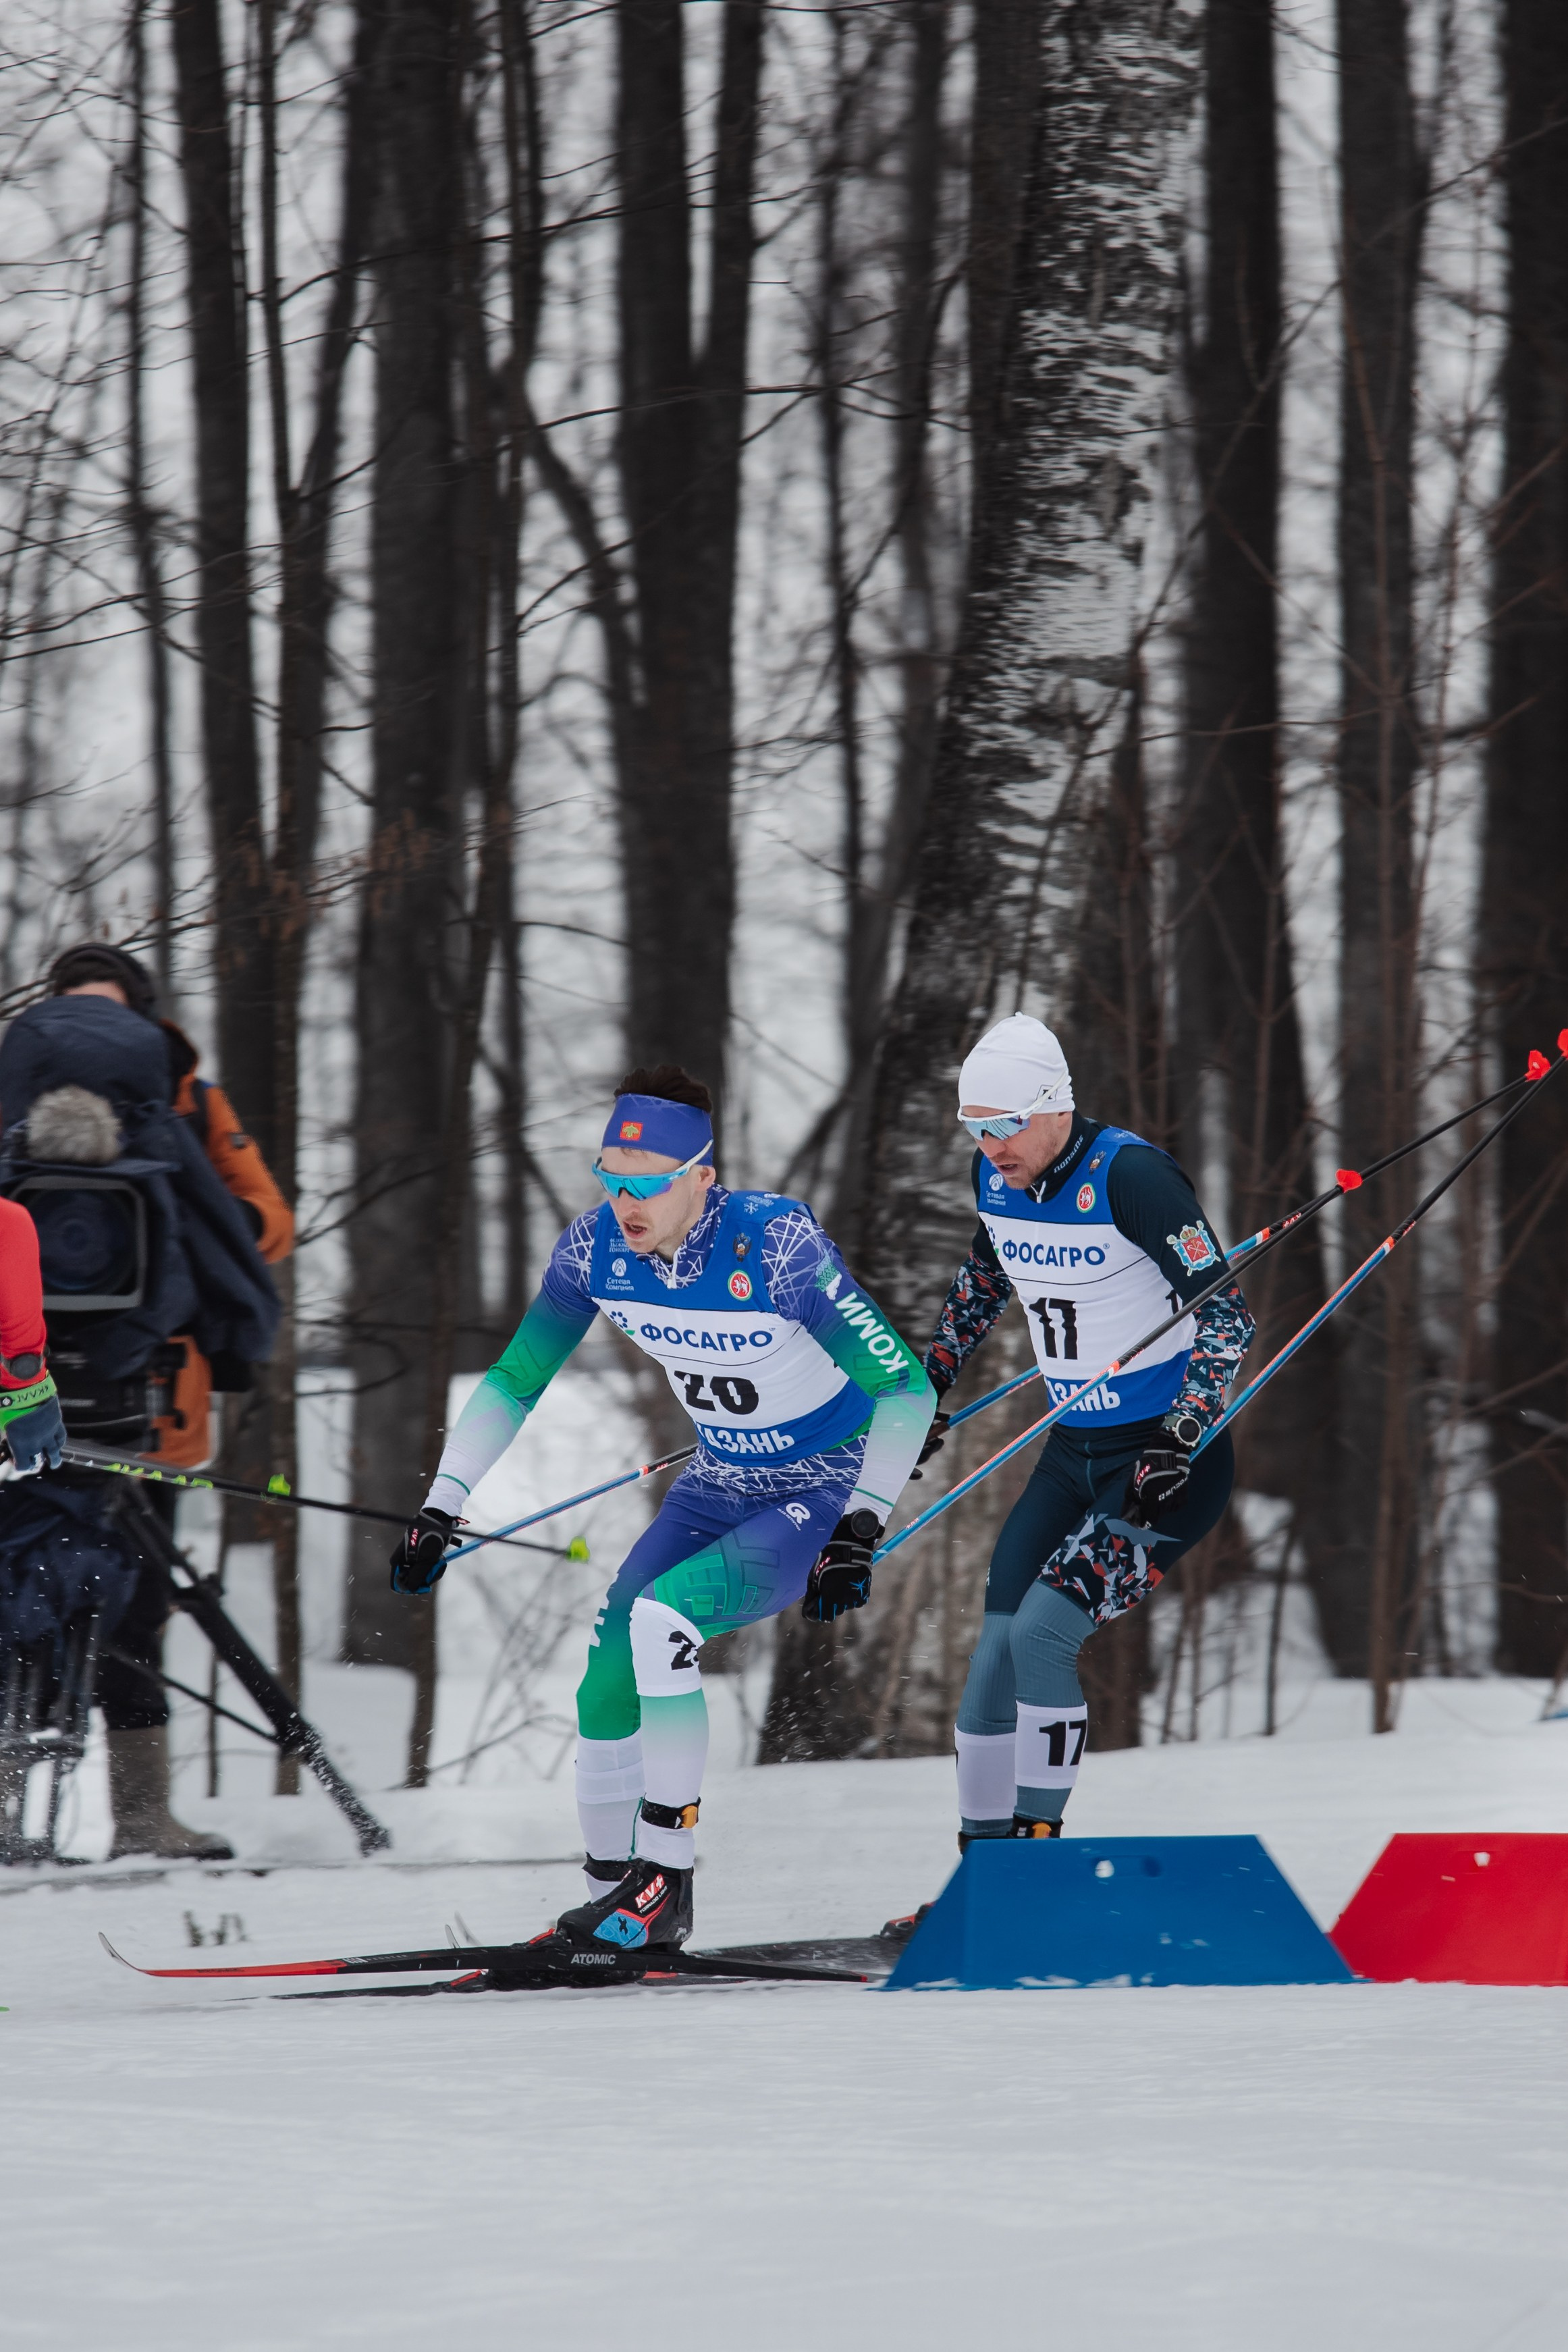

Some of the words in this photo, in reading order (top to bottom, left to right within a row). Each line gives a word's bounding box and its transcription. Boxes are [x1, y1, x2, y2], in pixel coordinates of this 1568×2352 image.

[1002, 1239, 1106, 1267] ФОСАГРО
[640, 1322, 773, 1352] ФОСАГРО
[835, 1291, 909, 1374] КОМИ
[1029, 1297, 1078, 1360] 17
[674, 1370, 759, 1416] 20
[1047, 1380, 1120, 1412] ЗАНЬ
[697, 1422, 795, 1453] АЗАНЬ
[668, 1630, 699, 1671] 2
[1039, 1718, 1087, 1767] 17
[635, 1875, 664, 1909] KV+
[570, 1953, 616, 1965] ATOMIC
